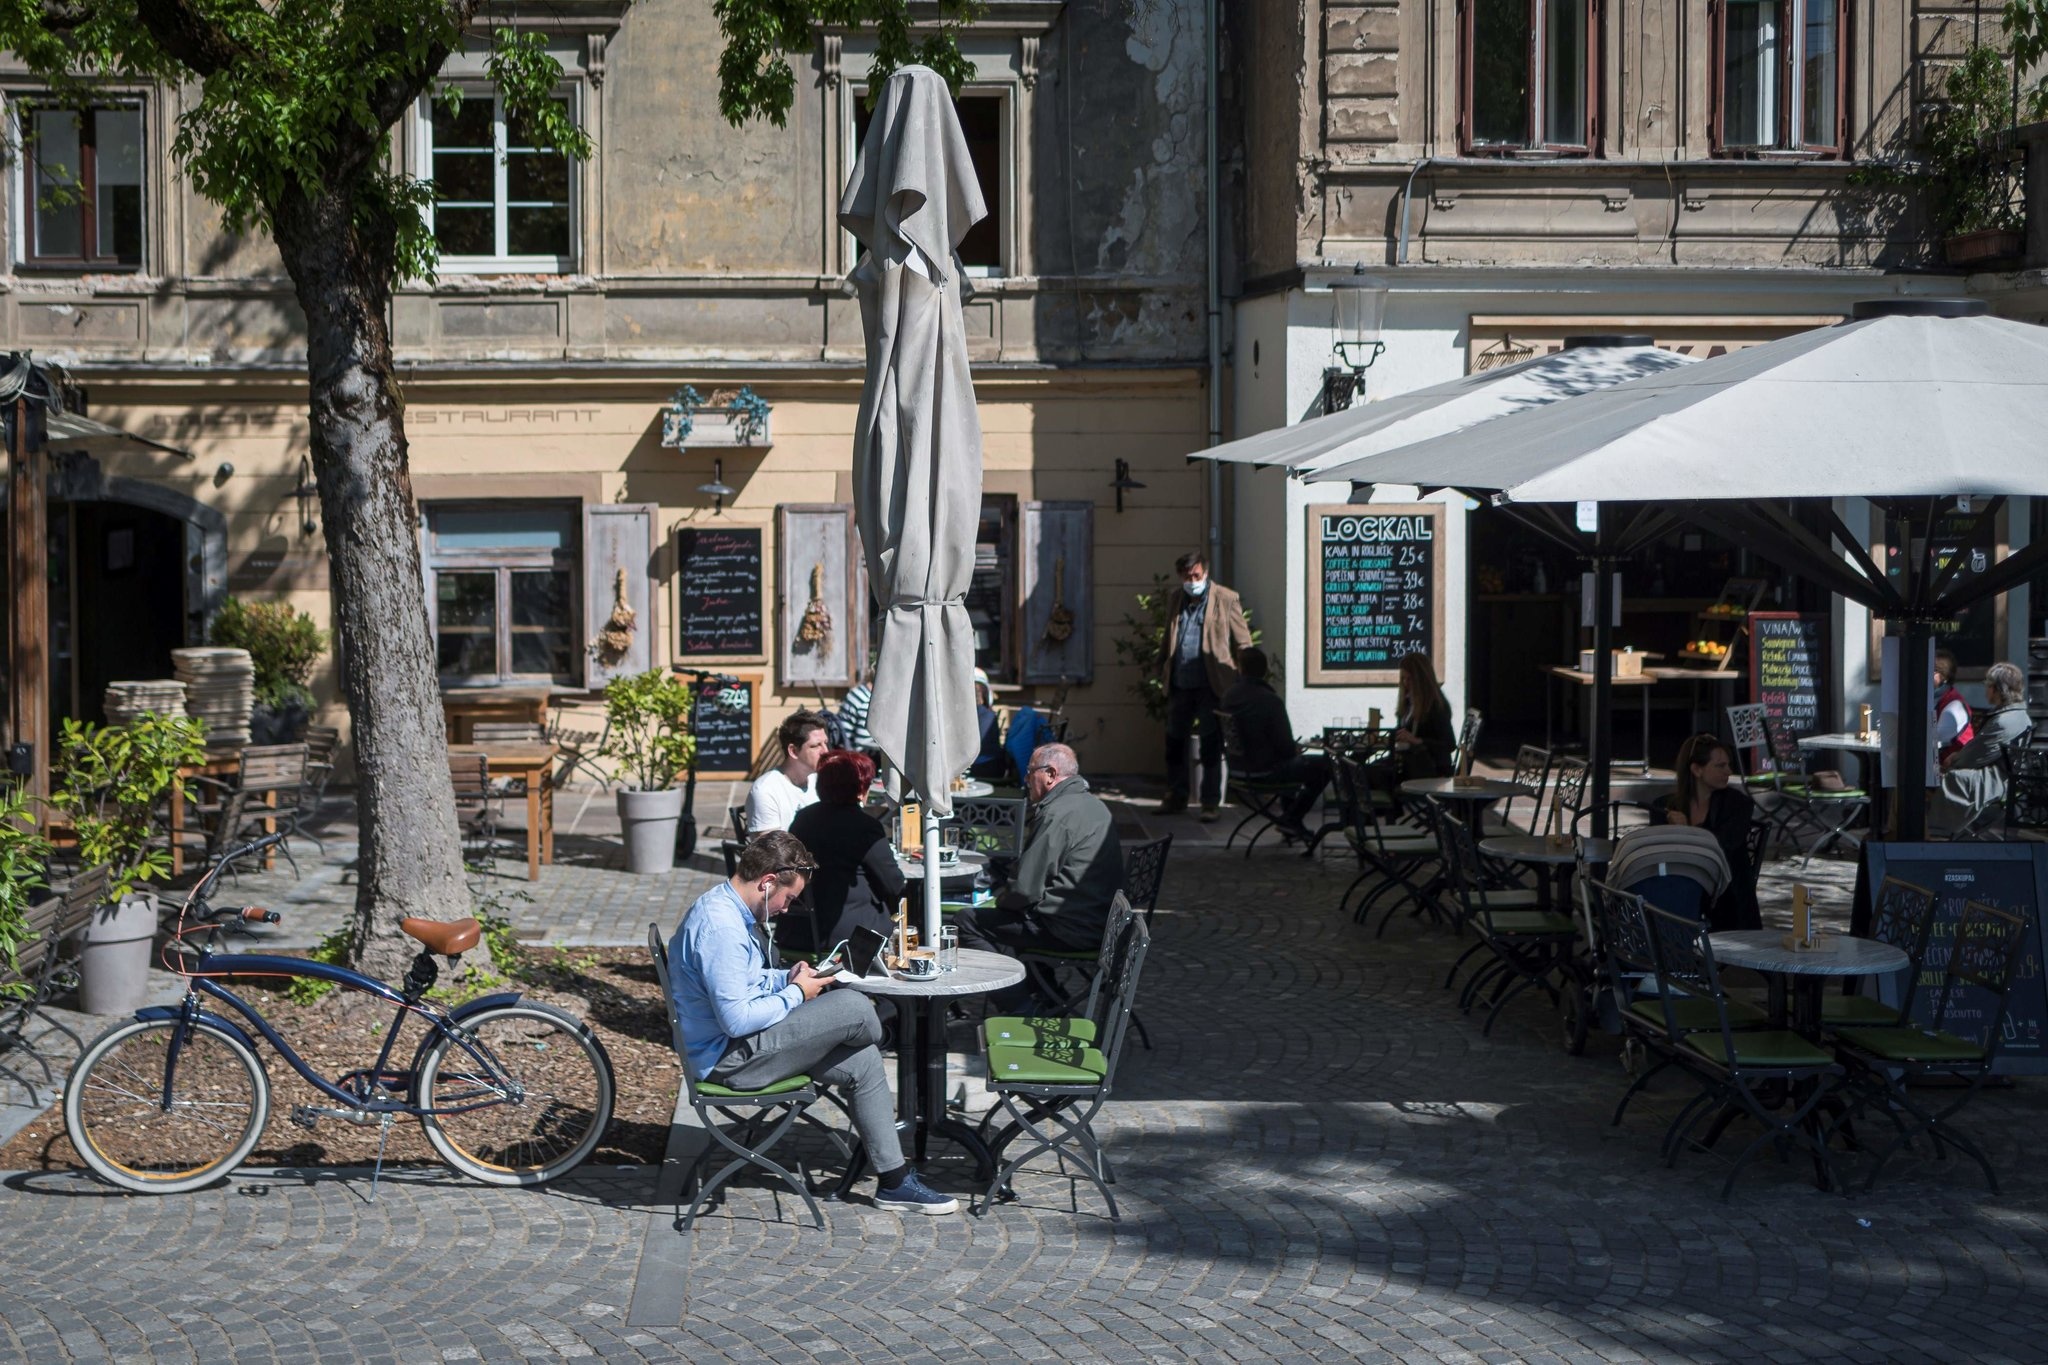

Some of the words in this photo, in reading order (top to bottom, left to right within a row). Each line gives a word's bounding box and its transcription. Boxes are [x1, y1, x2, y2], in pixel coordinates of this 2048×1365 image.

[404, 409, 601, 423] STAURANT
[1321, 516, 1432, 541] LOCKAL
[1325, 545, 1348, 557] KAVA
[1351, 545, 1360, 557] IN
[1325, 558, 1350, 569] COFFEE
[1325, 582, 1349, 592] GRILLED
[1325, 605, 1347, 616] DAILY
[1351, 605, 1370, 616] SOUP
[1325, 650, 1351, 662] SWEET
[1766, 707, 1783, 717] eran
[1932, 1009, 1982, 1019] POSCIUTTO
